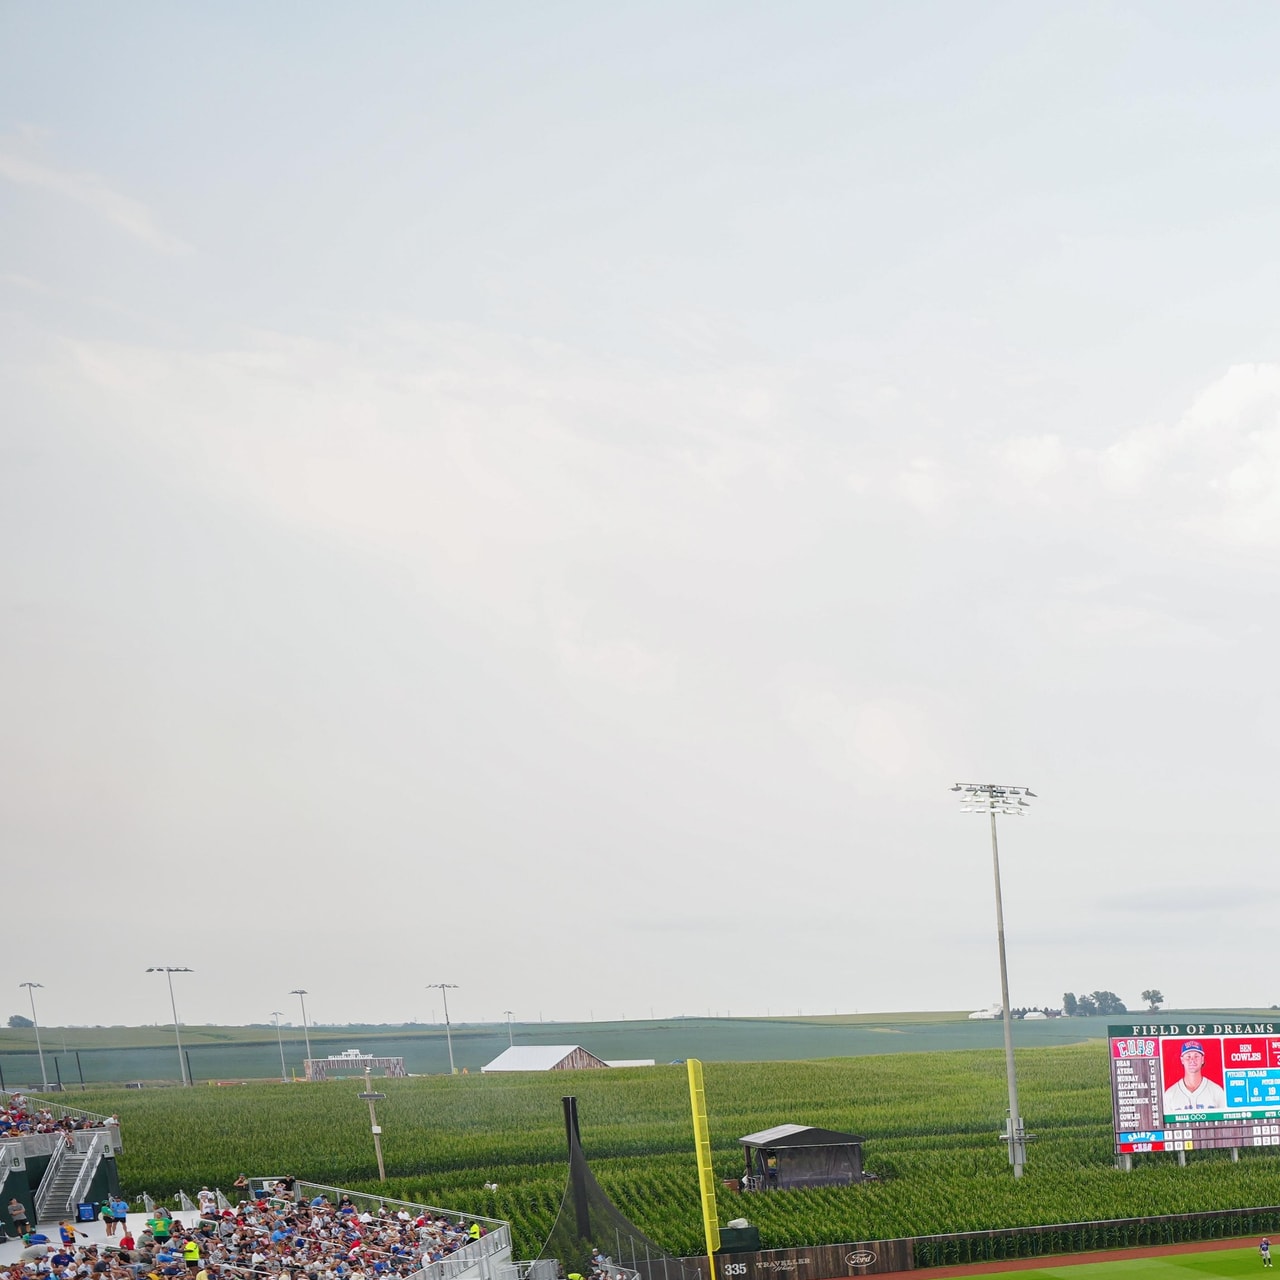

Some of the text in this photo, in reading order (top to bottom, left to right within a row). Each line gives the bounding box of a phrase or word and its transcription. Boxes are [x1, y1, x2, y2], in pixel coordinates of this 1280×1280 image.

[1132, 1023, 1274, 1035] FIELD OF DREAMS
[1117, 1040, 1155, 1057] CUBS
[1231, 1052, 1262, 1062] COWLES
[756, 1258, 811, 1269] TRAVELLER
[850, 1253, 872, 1264] Ford
[724, 1263, 747, 1276] 335
